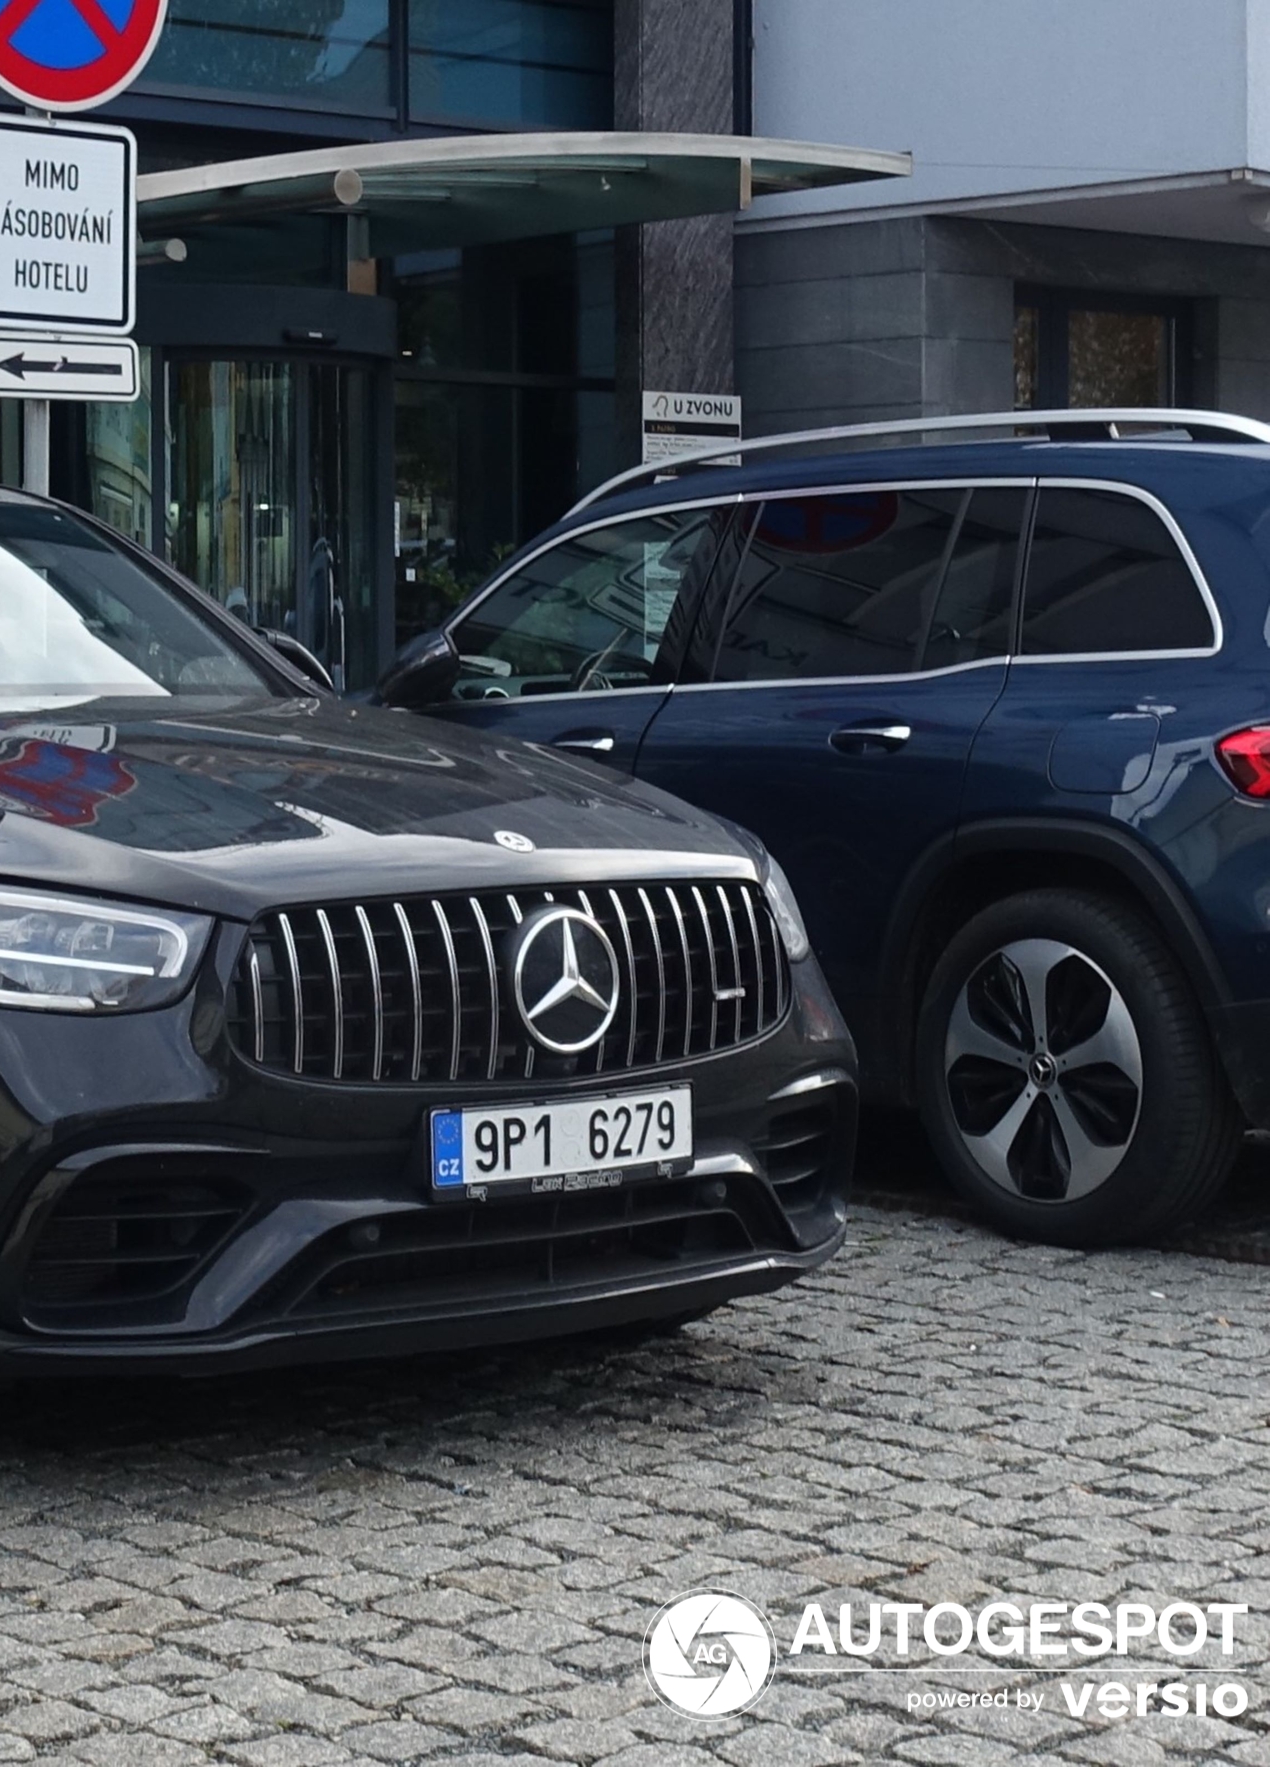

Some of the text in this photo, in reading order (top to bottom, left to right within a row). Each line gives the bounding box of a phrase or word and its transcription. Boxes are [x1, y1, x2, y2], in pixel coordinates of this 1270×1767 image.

[25, 158, 79, 191] MIMO
[15, 258, 88, 293] HOTELU
[674, 399, 733, 417] U ZVONU
[474, 1100, 676, 1173] 9P1 6279
[438, 1159, 460, 1176] CZ
